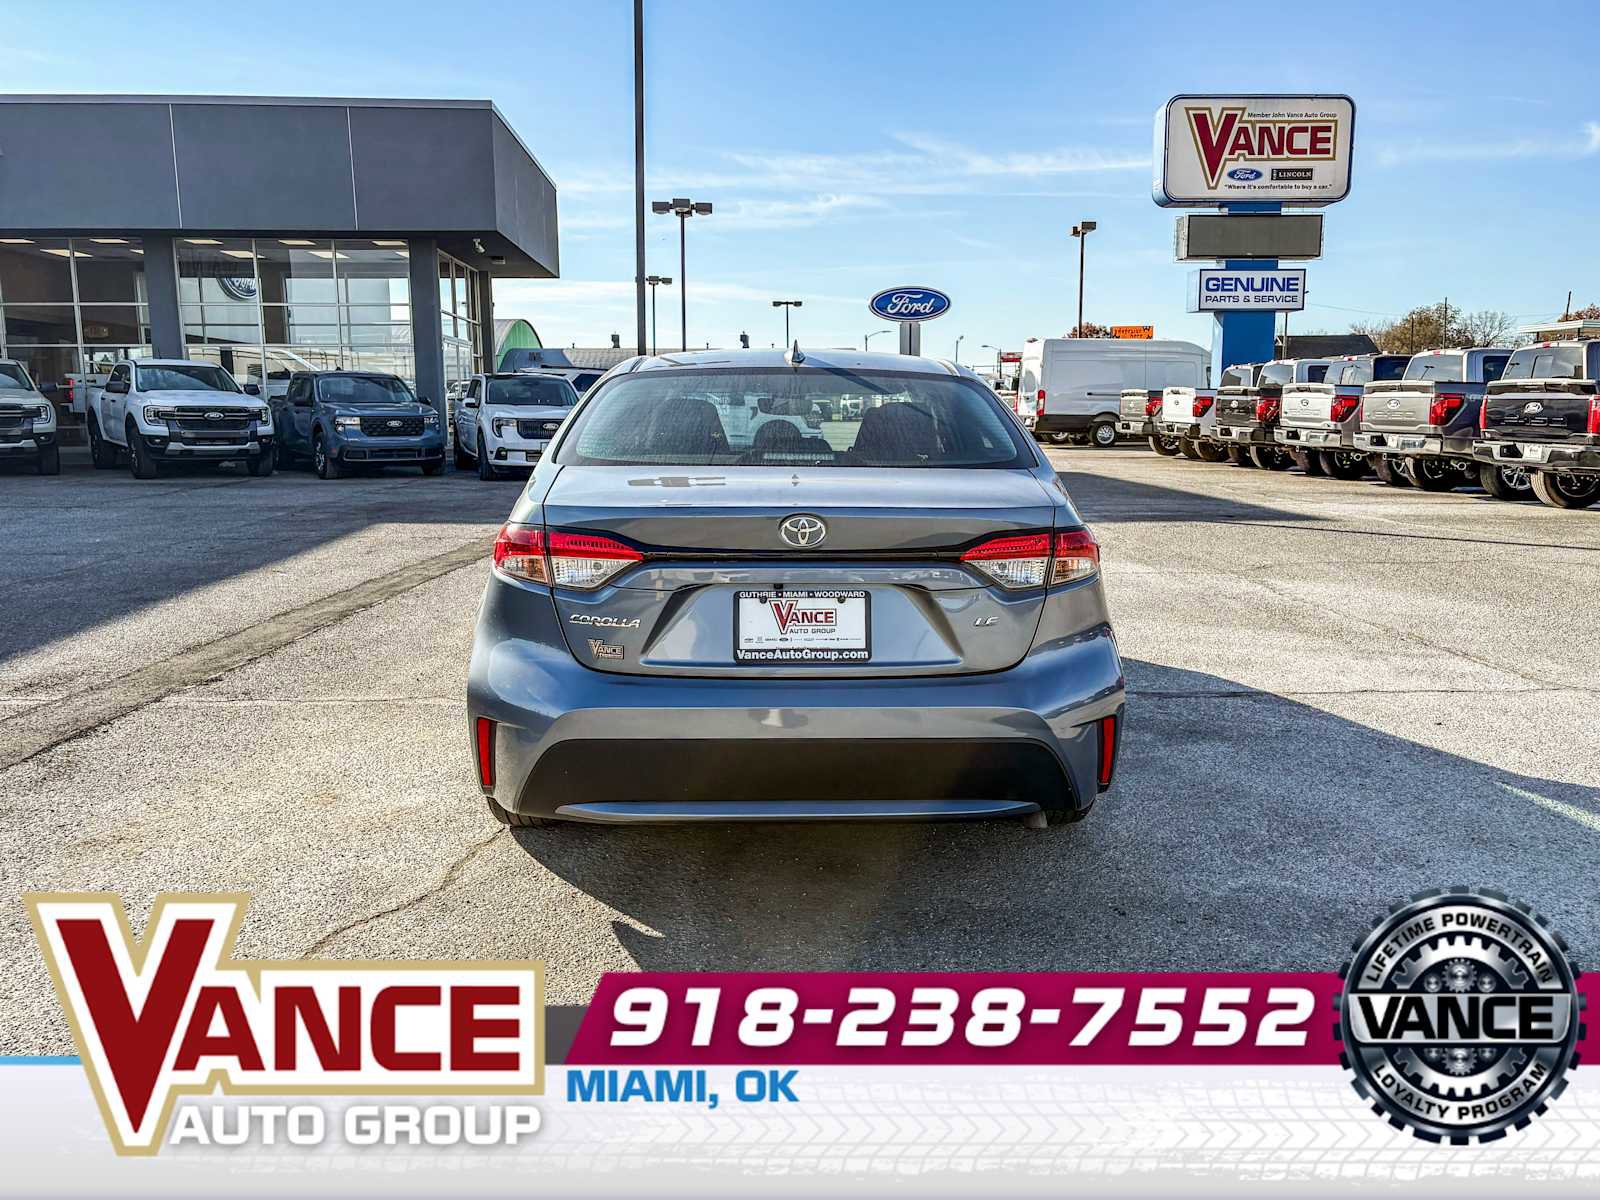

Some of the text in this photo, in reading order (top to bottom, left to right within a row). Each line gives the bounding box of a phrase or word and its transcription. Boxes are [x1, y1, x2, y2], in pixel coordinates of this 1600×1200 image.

[1192, 113, 1332, 183] VANCE
[1233, 169, 1257, 179] Ford
[1205, 277, 1299, 292] GENUINE
[887, 293, 935, 314] Ford
[1205, 295, 1298, 303] PARTS & SERVICE
[569, 614, 641, 628] COROLLA
[772, 602, 834, 632] VANCE
[588, 640, 622, 659] VANCE
[737, 650, 869, 661] VanceAutoGroup.com
